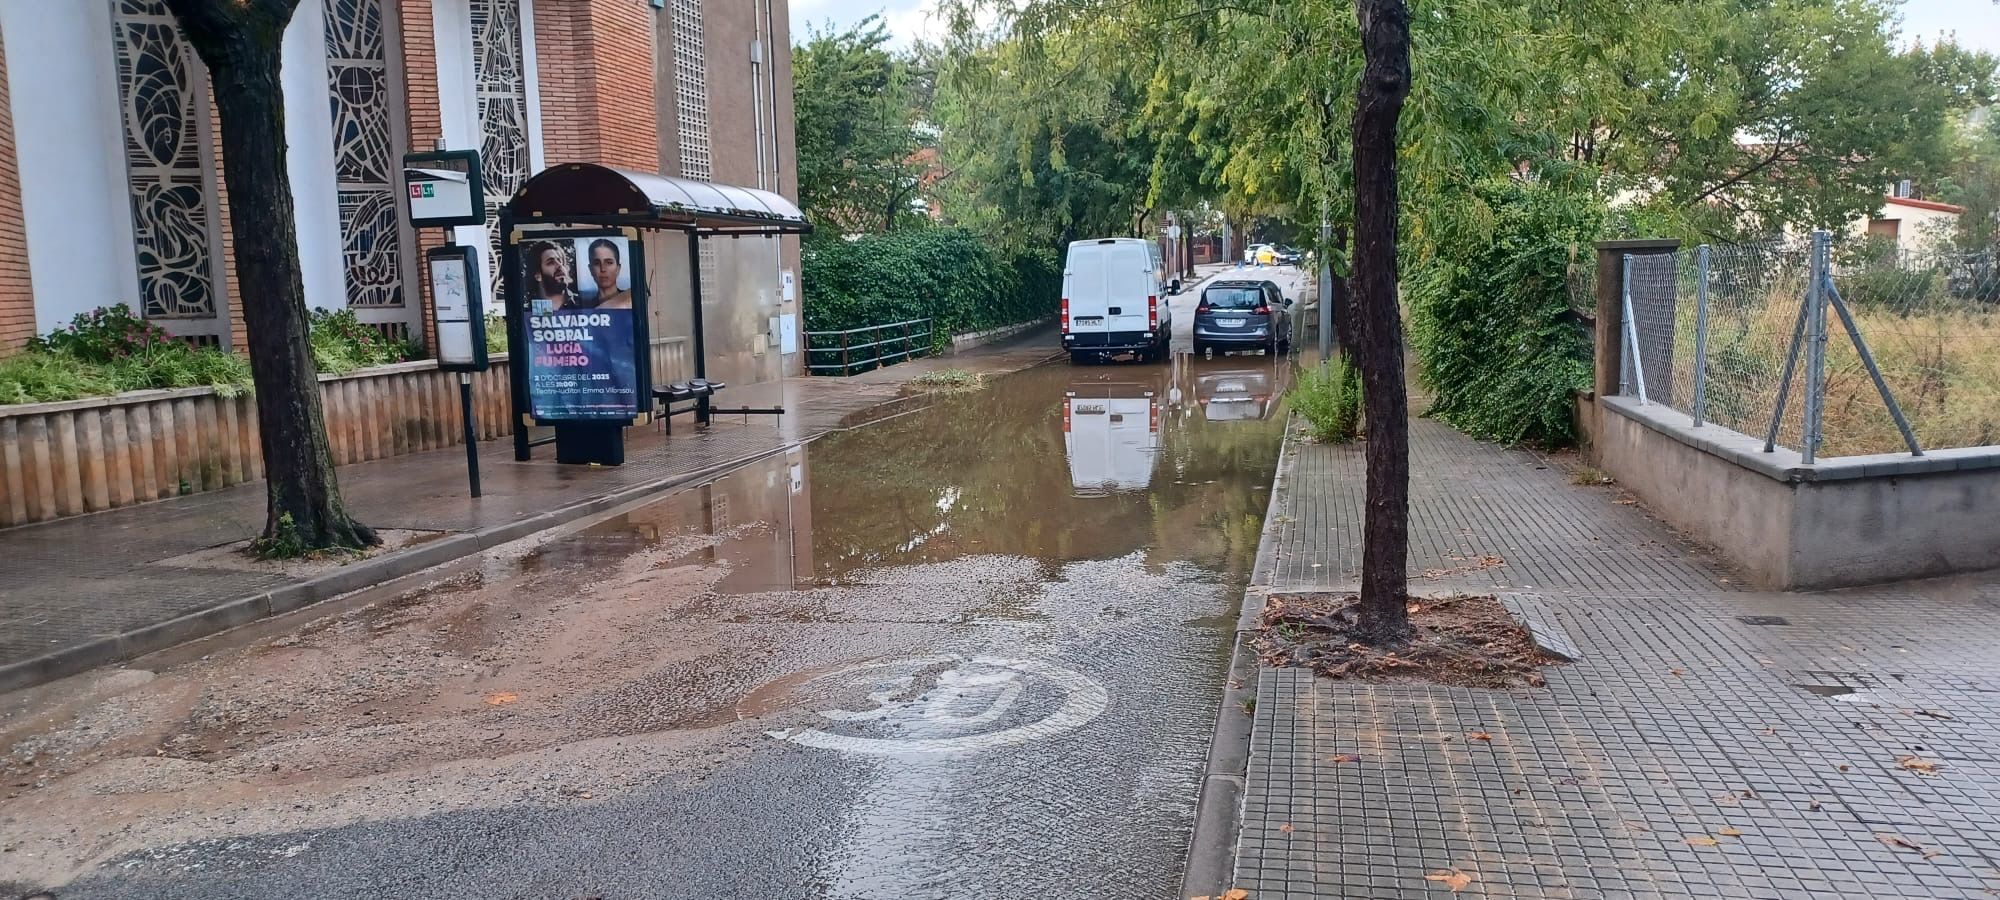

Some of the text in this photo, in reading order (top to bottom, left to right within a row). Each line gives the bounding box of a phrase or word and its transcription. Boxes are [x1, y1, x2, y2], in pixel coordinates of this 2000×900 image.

[530, 314, 611, 328] SALVADOR
[533, 328, 594, 342] SOBRAL
[535, 355, 589, 367] FUMERO
